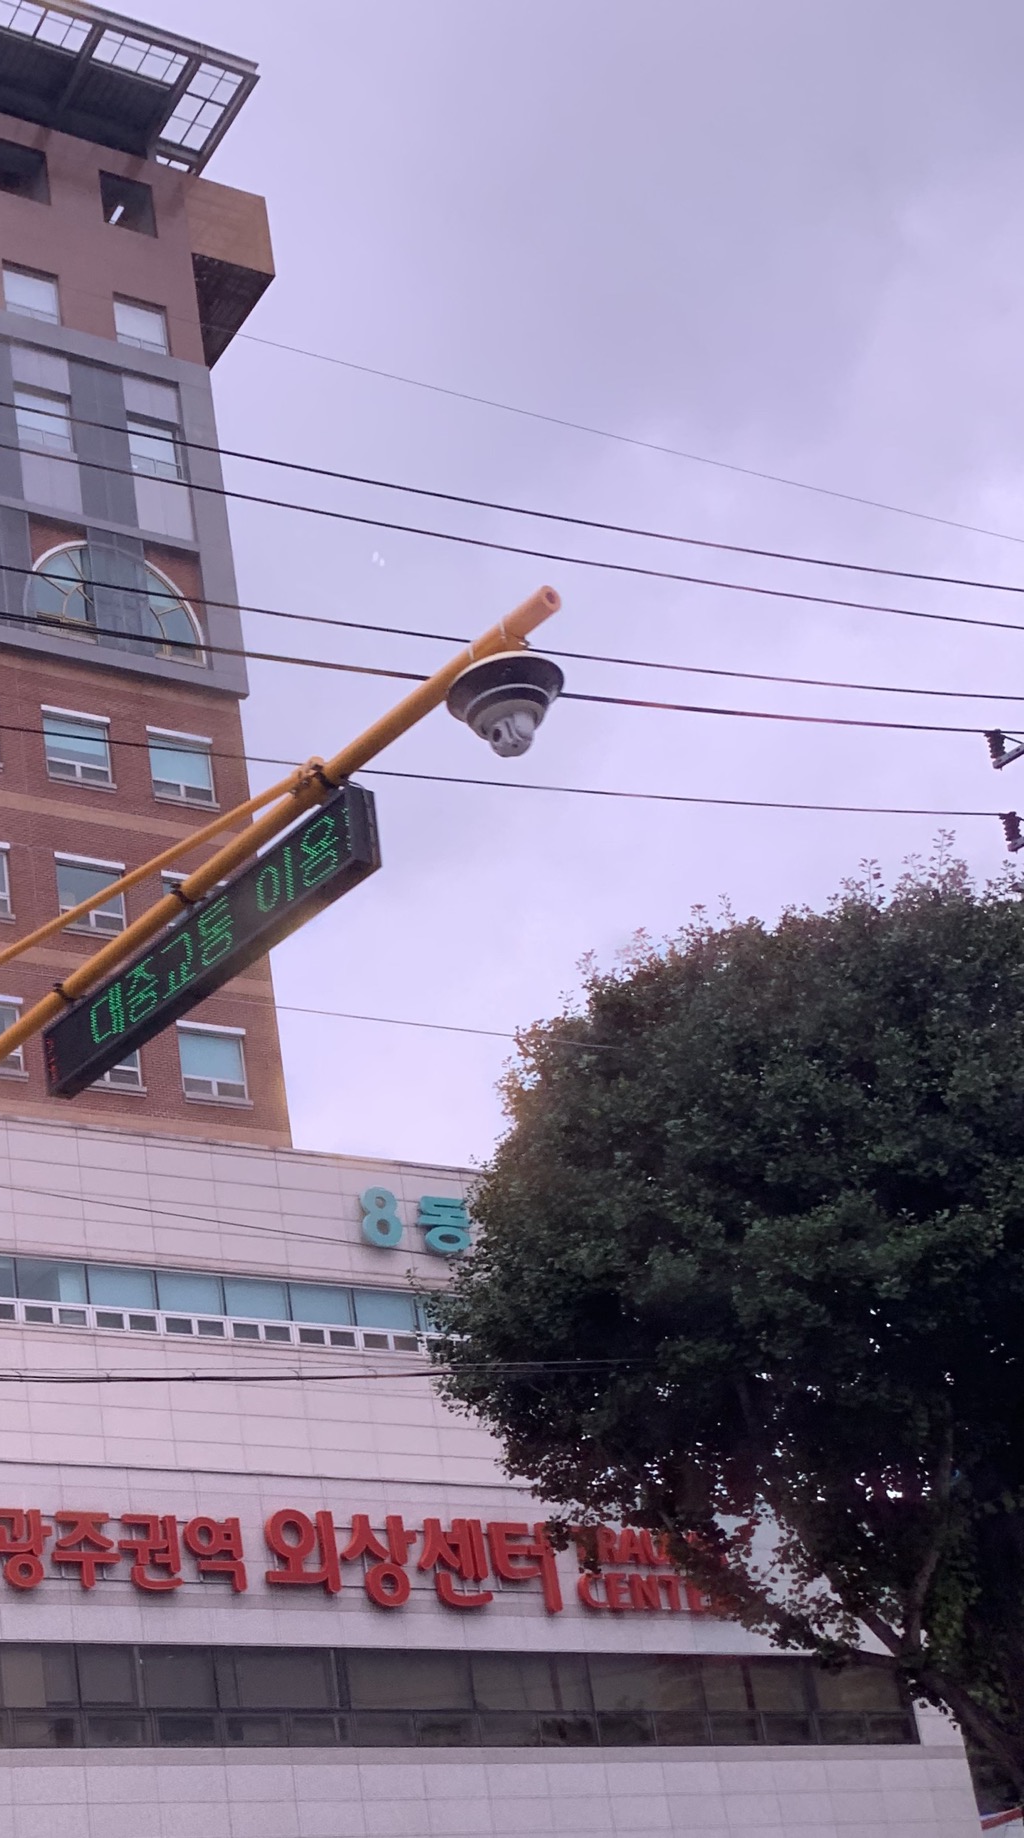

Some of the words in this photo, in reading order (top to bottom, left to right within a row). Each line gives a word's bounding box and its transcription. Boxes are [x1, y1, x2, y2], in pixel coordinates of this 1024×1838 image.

[90, 895, 234, 1044] 대중교통
[255, 808, 350, 914] 이용
[360, 1186, 472, 1254] 8동
[265, 1507, 564, 1614] 외상센터
[578, 1570, 732, 1614] CENTE
